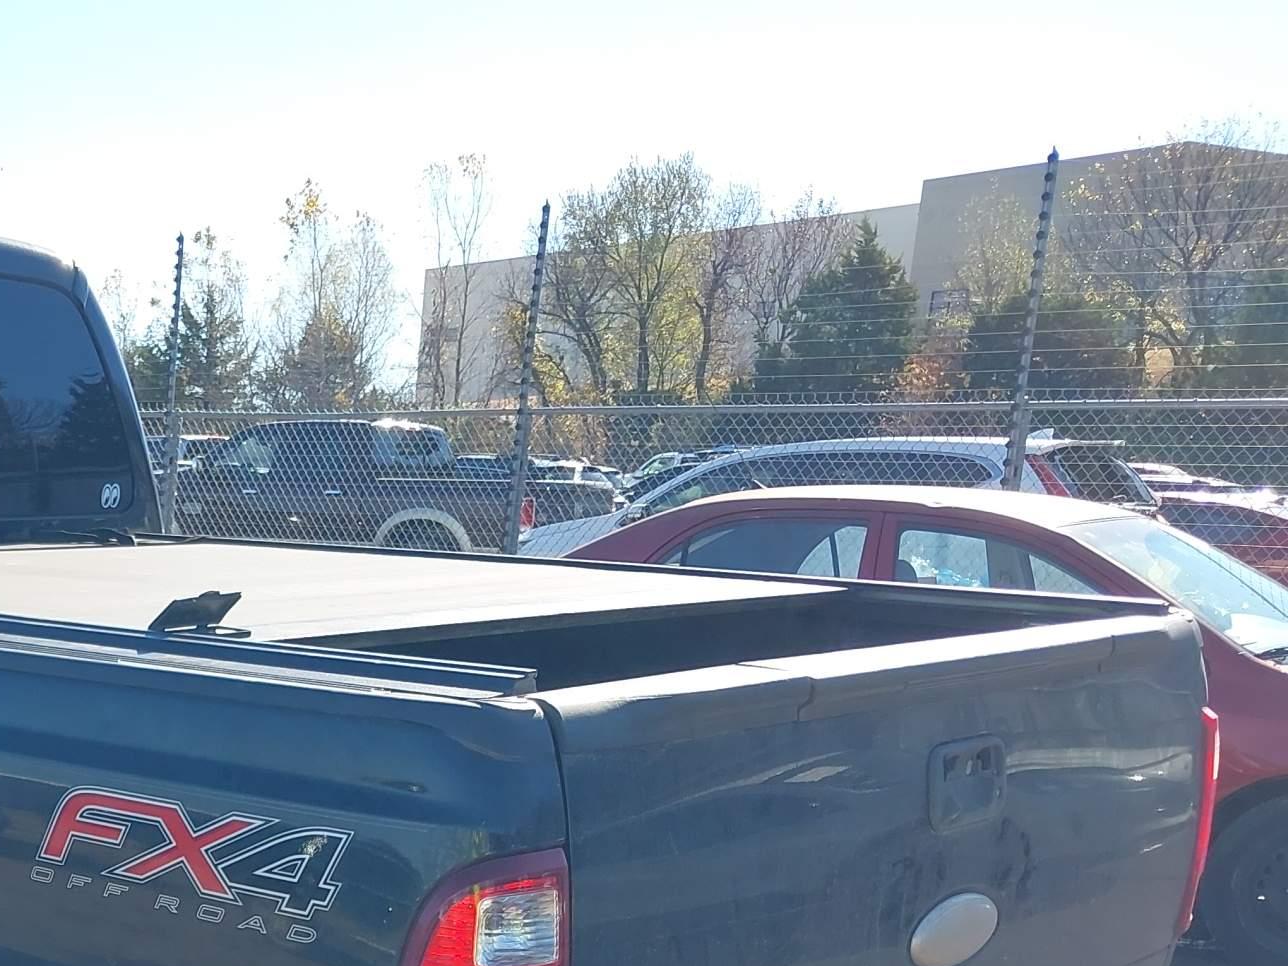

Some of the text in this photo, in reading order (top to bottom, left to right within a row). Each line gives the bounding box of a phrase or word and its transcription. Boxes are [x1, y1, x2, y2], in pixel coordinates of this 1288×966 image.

[30, 866, 318, 944] OFF ROAD
[36, 785, 355, 920] FX4
